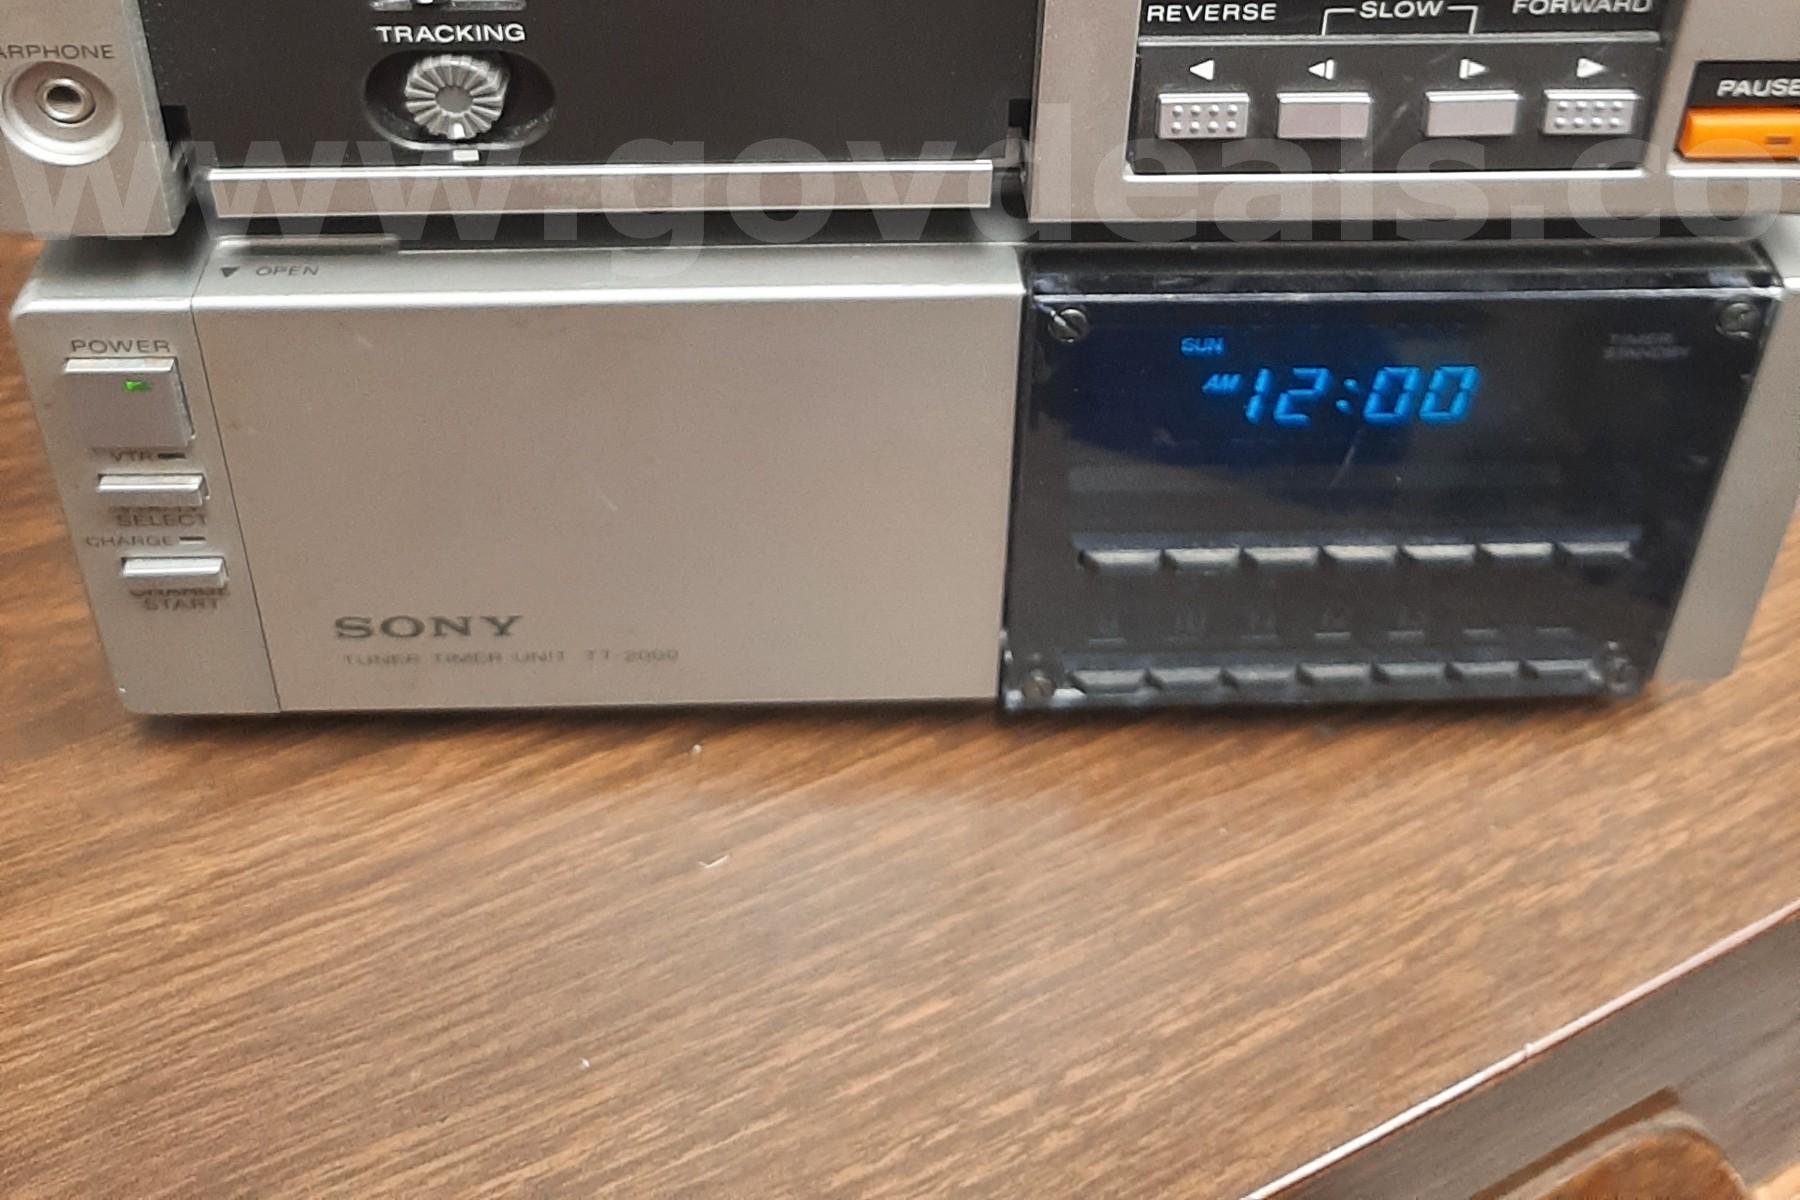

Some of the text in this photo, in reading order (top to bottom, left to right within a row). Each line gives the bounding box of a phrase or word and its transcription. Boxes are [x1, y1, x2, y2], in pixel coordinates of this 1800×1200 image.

[1146, 3, 1277, 23] REVERSE
[1359, 0, 1445, 19] SLOW
[375, 23, 526, 44] TRACKING
[1716, 78, 1800, 98] PAUSE
[255, 264, 320, 277] OPEN
[71, 338, 171, 354] POWER
[1180, 336, 1225, 356] SUN
[1201, 364, 1481, 427] AM 12:00
[116, 513, 208, 528] SELECT
[86, 534, 174, 547] CHARGE
[143, 599, 218, 611] START
[334, 615, 523, 639] SONY
